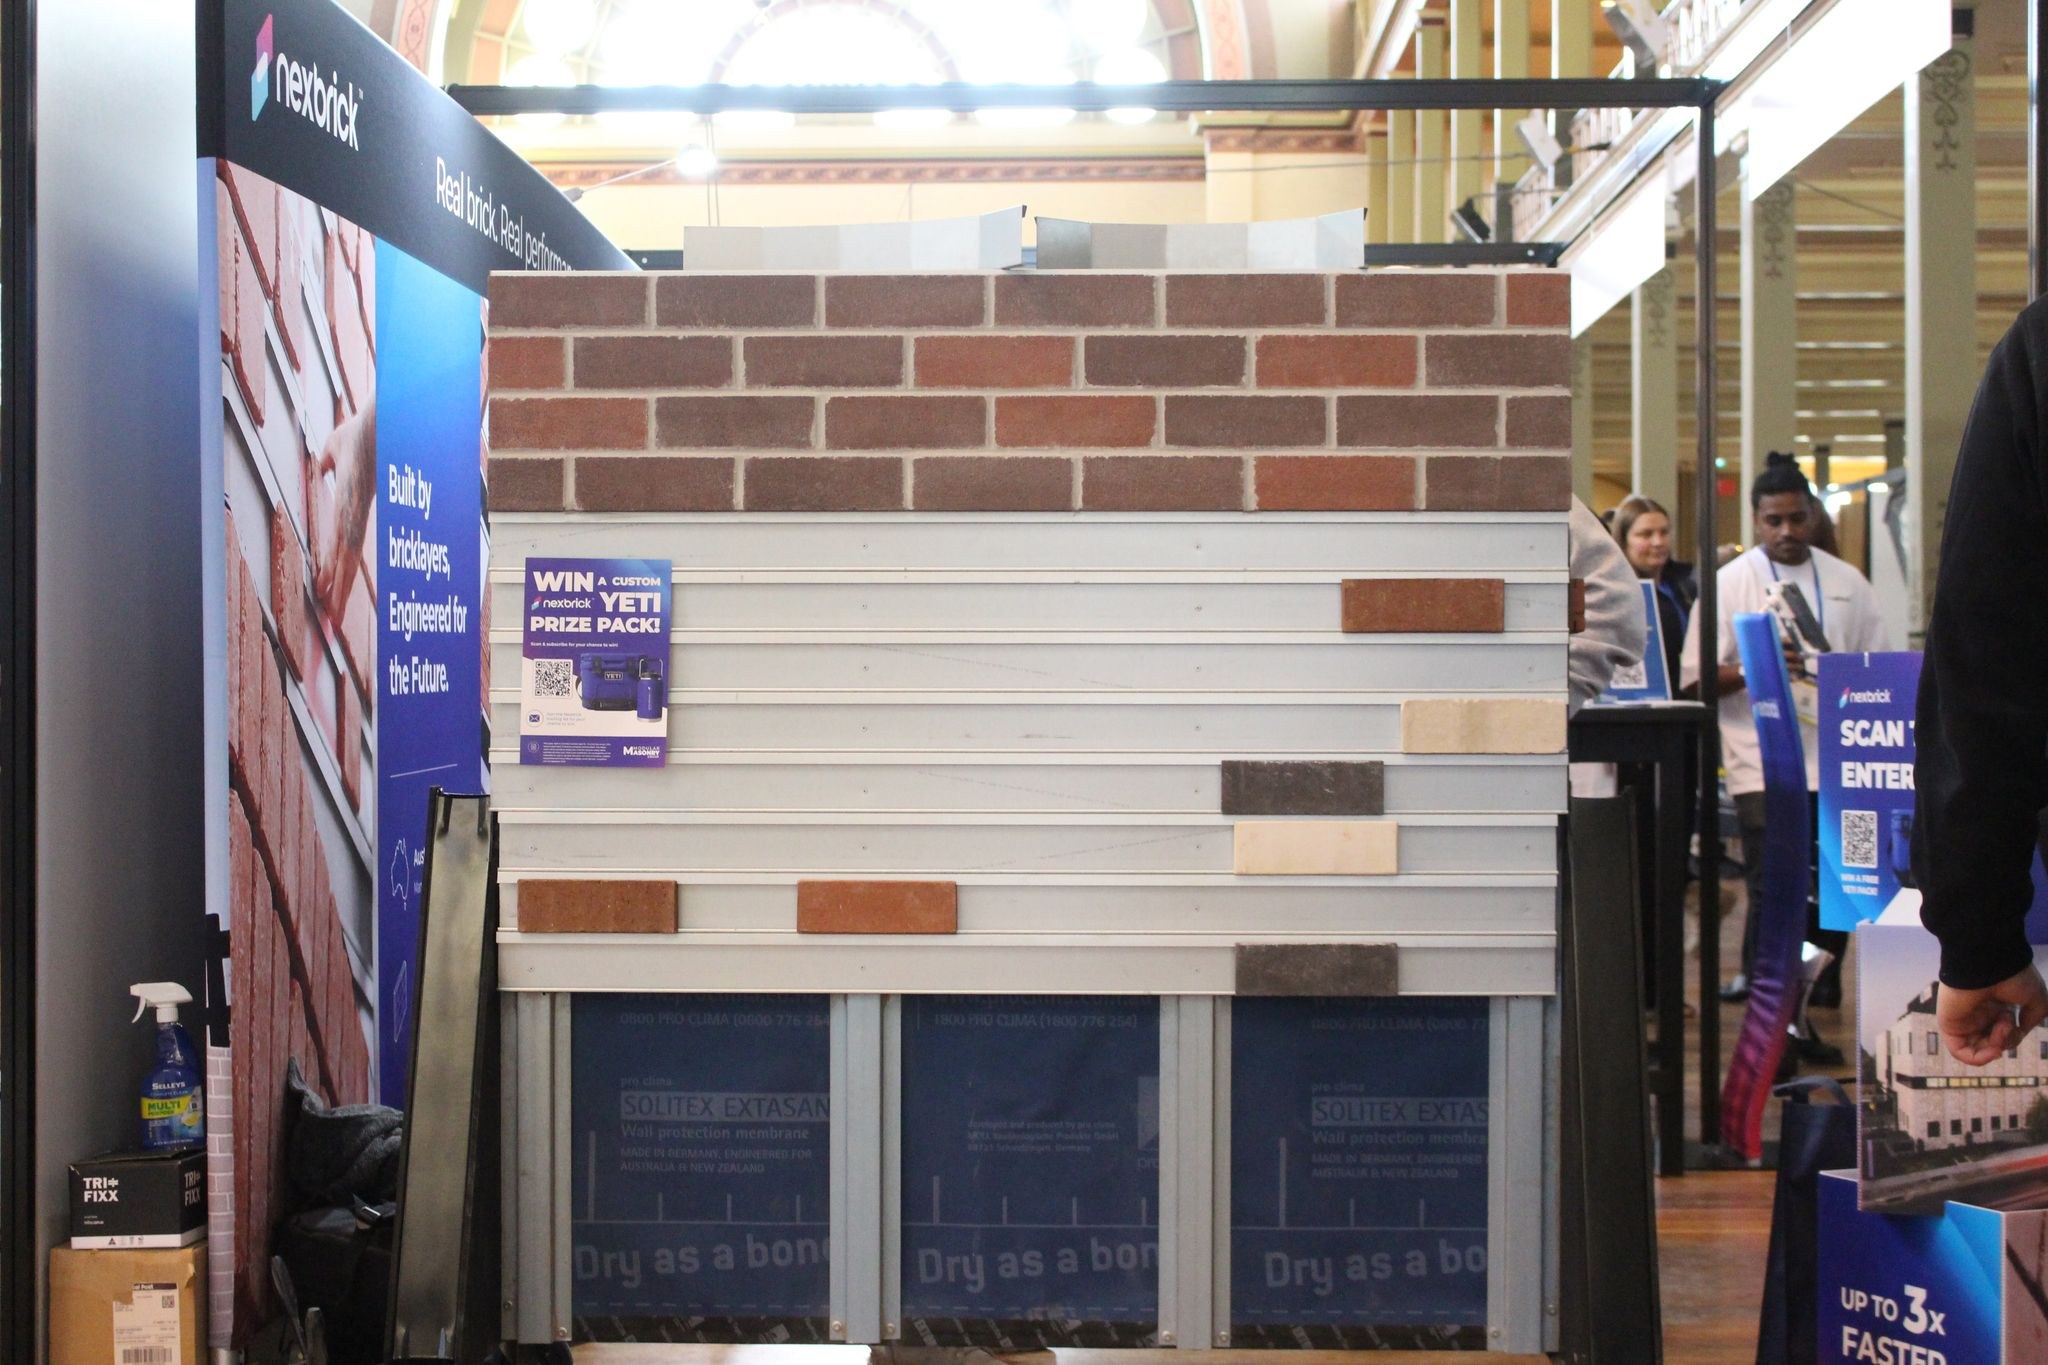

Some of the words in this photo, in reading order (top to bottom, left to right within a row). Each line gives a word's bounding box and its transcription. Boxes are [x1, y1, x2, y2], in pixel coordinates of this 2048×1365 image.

[277, 52, 359, 151] nexbrick
[437, 156, 464, 219] Real
[467, 175, 498, 243] brick.
[501, 204, 523, 259] Real
[389, 463, 416, 508] Built
[418, 469, 432, 521] by
[390, 525, 450, 582] bricklayers,
[533, 571, 594, 592] WIN
[598, 577, 607, 586] A
[612, 577, 661, 586] CUSTOM
[543, 597, 591, 609] nexbrick
[599, 592, 661, 613] YETI
[390, 590, 452, 642] Engineered
[453, 595, 467, 633] for
[530, 616, 592, 632] PRIZE
[597, 617, 661, 633] PACK!
[389, 654, 409, 695] the
[412, 655, 449, 694] Future.
[1850, 689, 1891, 703] nexbrick
[1840, 719, 1905, 747] SCAN
[623, 746, 660, 756] MASONRY
[1842, 762, 1915, 790] ENTER
[688, 1014, 729, 1026] CLIMA
[996, 1014, 1037, 1027] CLIMA
[152, 1081, 186, 1090] SELLEYS
[148, 1101, 181, 1112] MULTI
[623, 1094, 714, 1117] SOLITEX
[1315, 1100, 1407, 1122] SOLITEX
[1418, 1101, 1488, 1124] EXTAS
[621, 1124, 653, 1138] Wall
[658, 1124, 731, 1141] protection
[735, 1126, 810, 1140] membrane
[1312, 1130, 1345, 1144] Wall
[1350, 1130, 1424, 1147] protection
[620, 1161, 675, 1173] AUSTRALIA
[690, 1163, 715, 1173] NEW
[717, 1163, 765, 1174] ZEALAND
[83, 1190, 119, 1203] FIXX
[184, 1187, 200, 1207] FIXX
[575, 1245, 642, 1289] Dry
[654, 1246, 700, 1275] as
[713, 1243, 735, 1270] a
[918, 1248, 985, 1294] Dry
[1000, 1250, 1045, 1278] as
[1057, 1247, 1079, 1274] a
[1264, 1251, 1333, 1296] Dry
[1347, 1251, 1393, 1281] as
[1405, 1249, 1428, 1277] a
[1841, 1286, 1868, 1312] UP
[1871, 1294, 1899, 1321] TO
[1903, 1284, 1946, 1336] 3x
